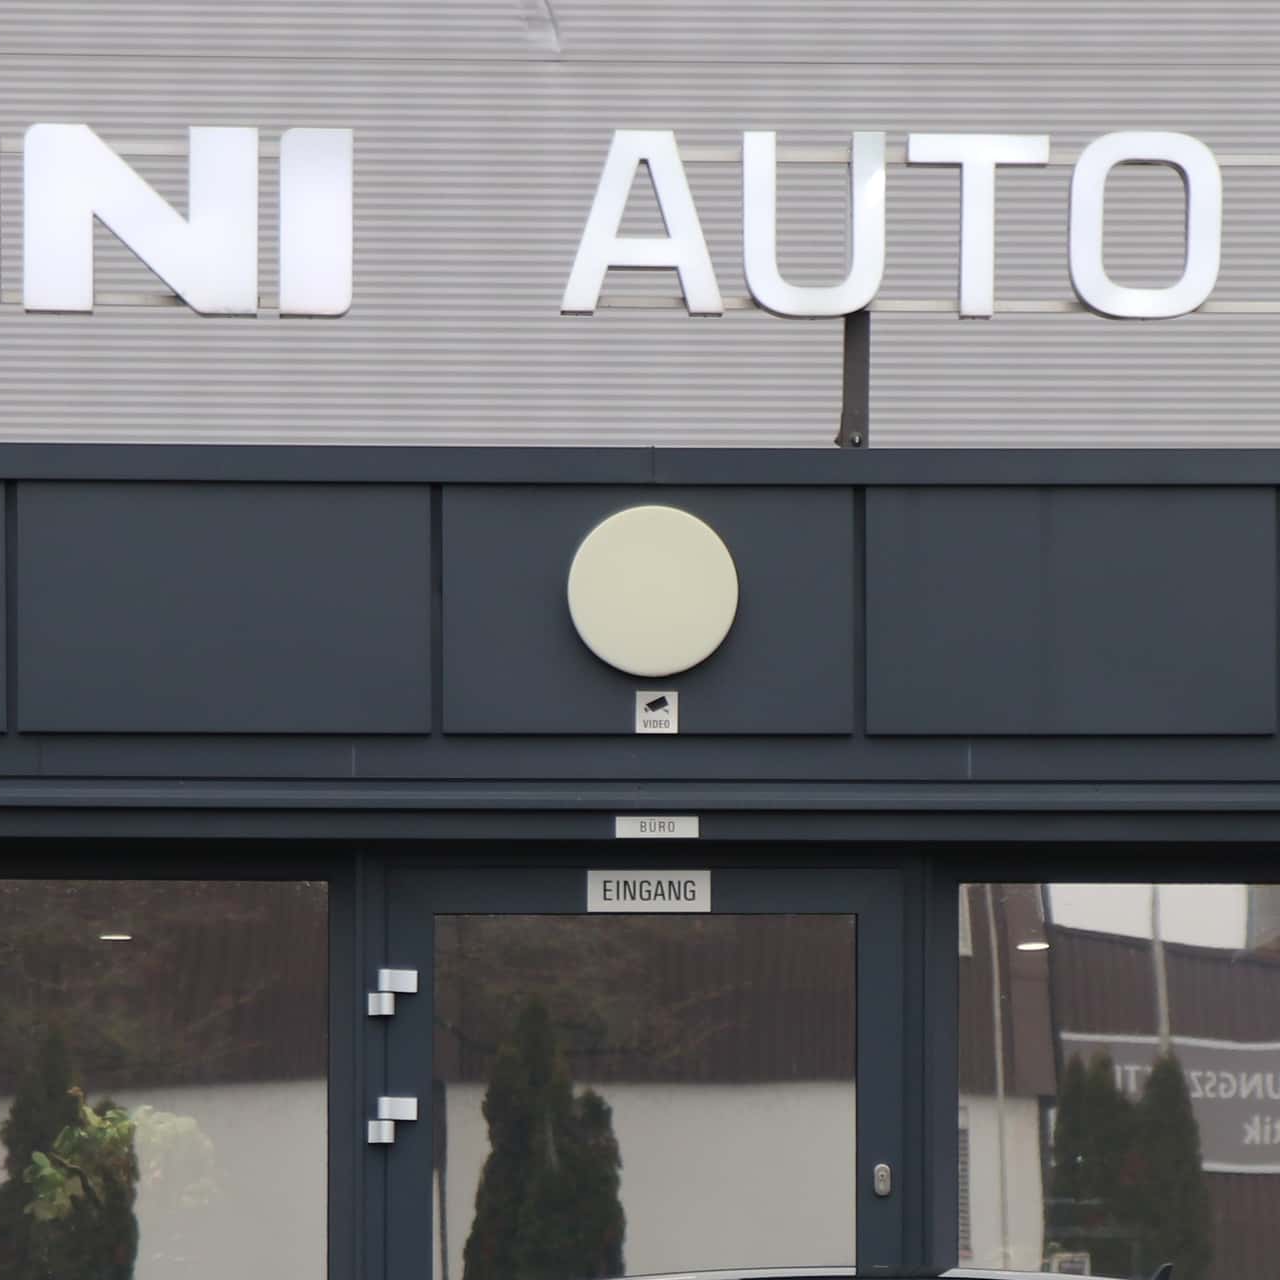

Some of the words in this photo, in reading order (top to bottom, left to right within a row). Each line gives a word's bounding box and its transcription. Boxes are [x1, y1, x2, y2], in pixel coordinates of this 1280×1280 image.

[560, 129, 1222, 317] AUTO
[642, 719, 671, 729] VIDEO
[639, 818, 676, 833] BÜRO
[602, 879, 697, 902] EINGANG
